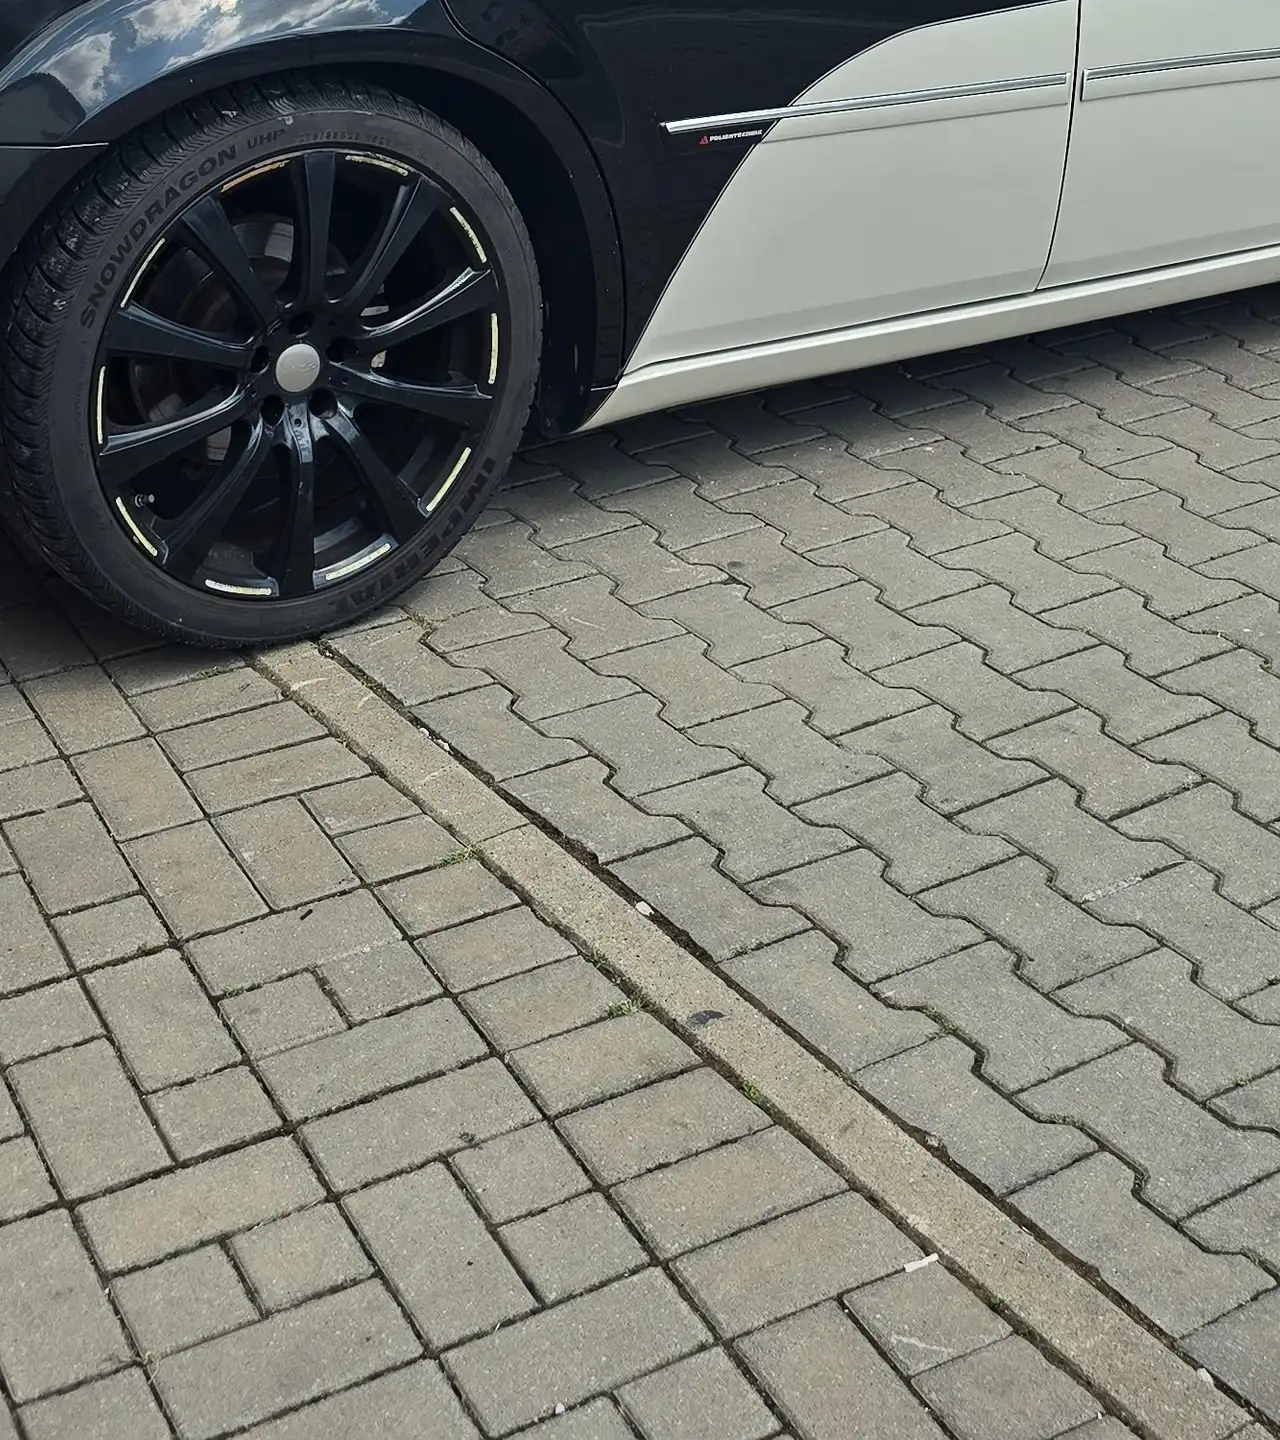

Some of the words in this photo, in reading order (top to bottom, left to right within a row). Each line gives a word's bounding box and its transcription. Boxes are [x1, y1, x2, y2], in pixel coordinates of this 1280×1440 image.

[247, 128, 287, 150] UHP
[81, 144, 239, 330] SNOWDRAGON
[328, 457, 497, 610] IMPERIAL
